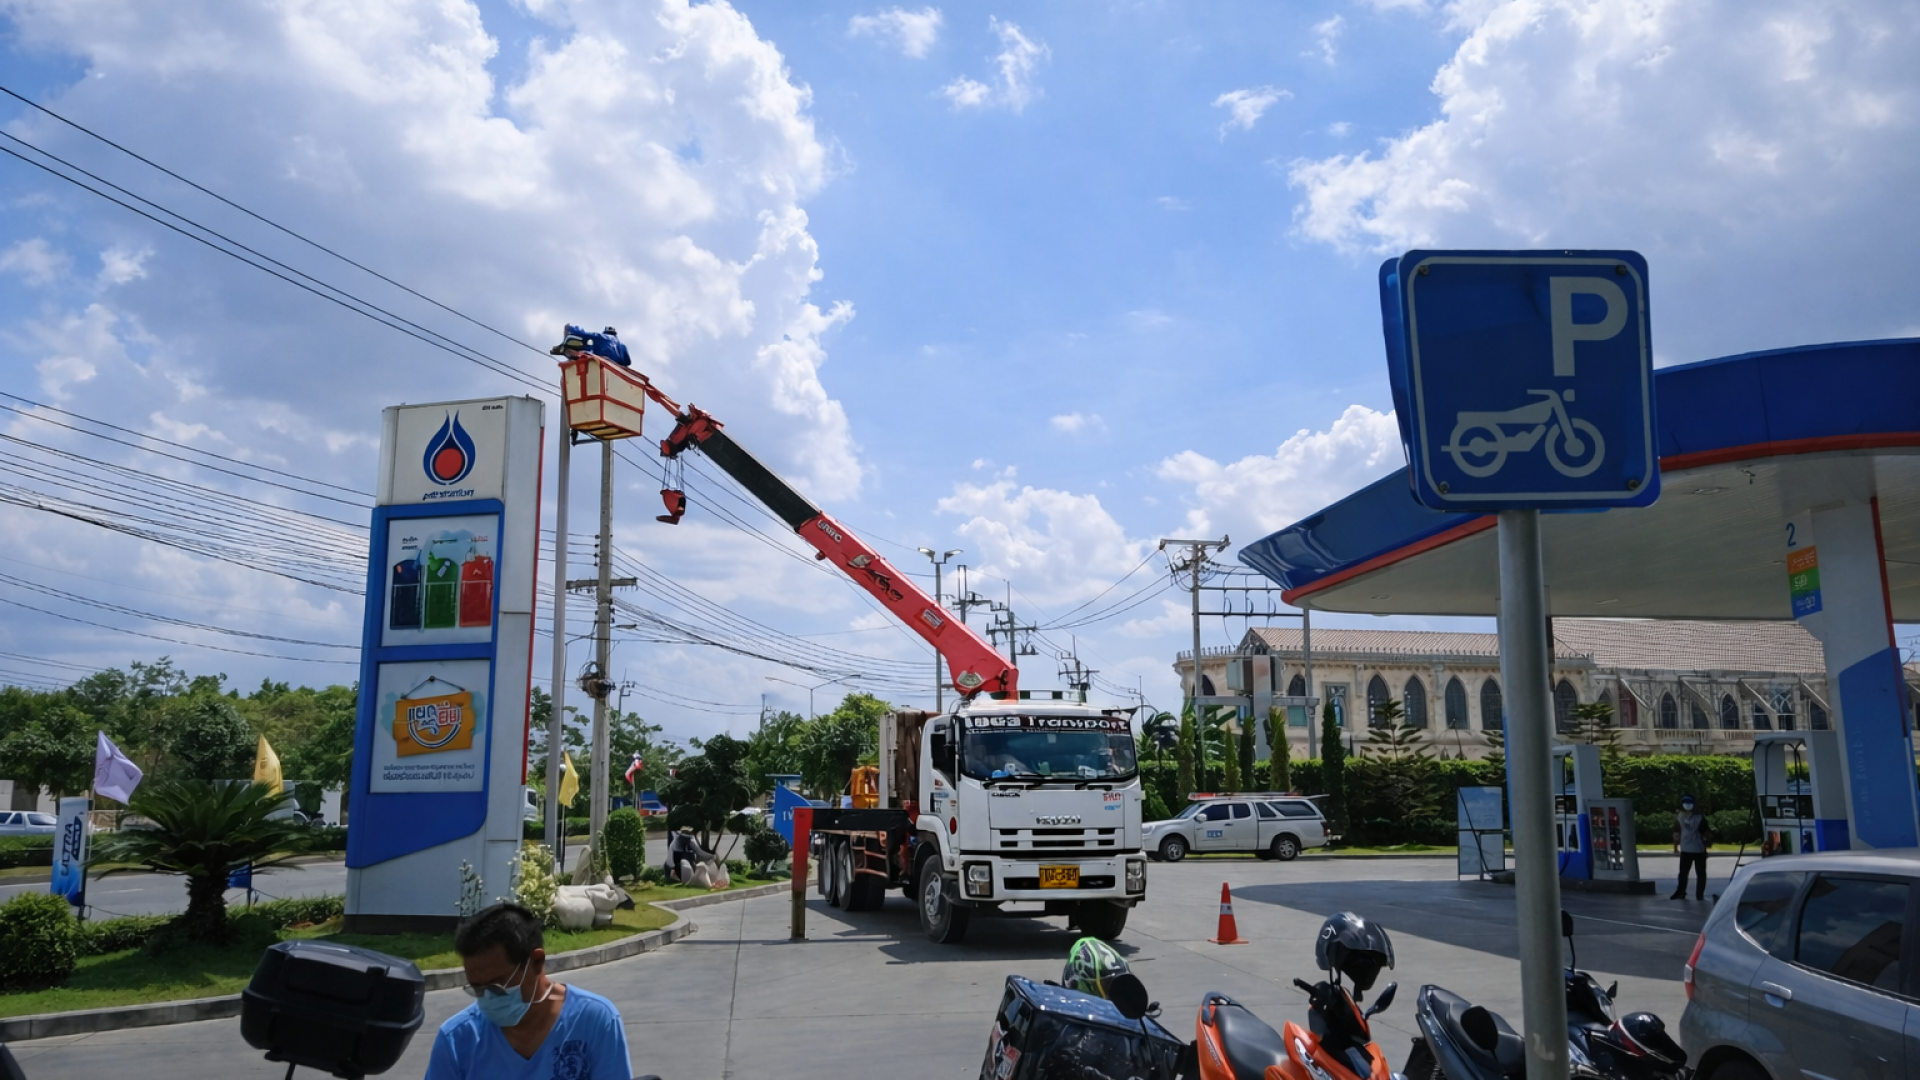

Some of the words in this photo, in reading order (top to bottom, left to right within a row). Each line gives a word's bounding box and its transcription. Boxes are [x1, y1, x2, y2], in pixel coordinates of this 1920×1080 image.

[1549, 275, 1629, 377] P
[1785, 522, 1796, 547] 2
[61, 823, 73, 876] ULTRA
